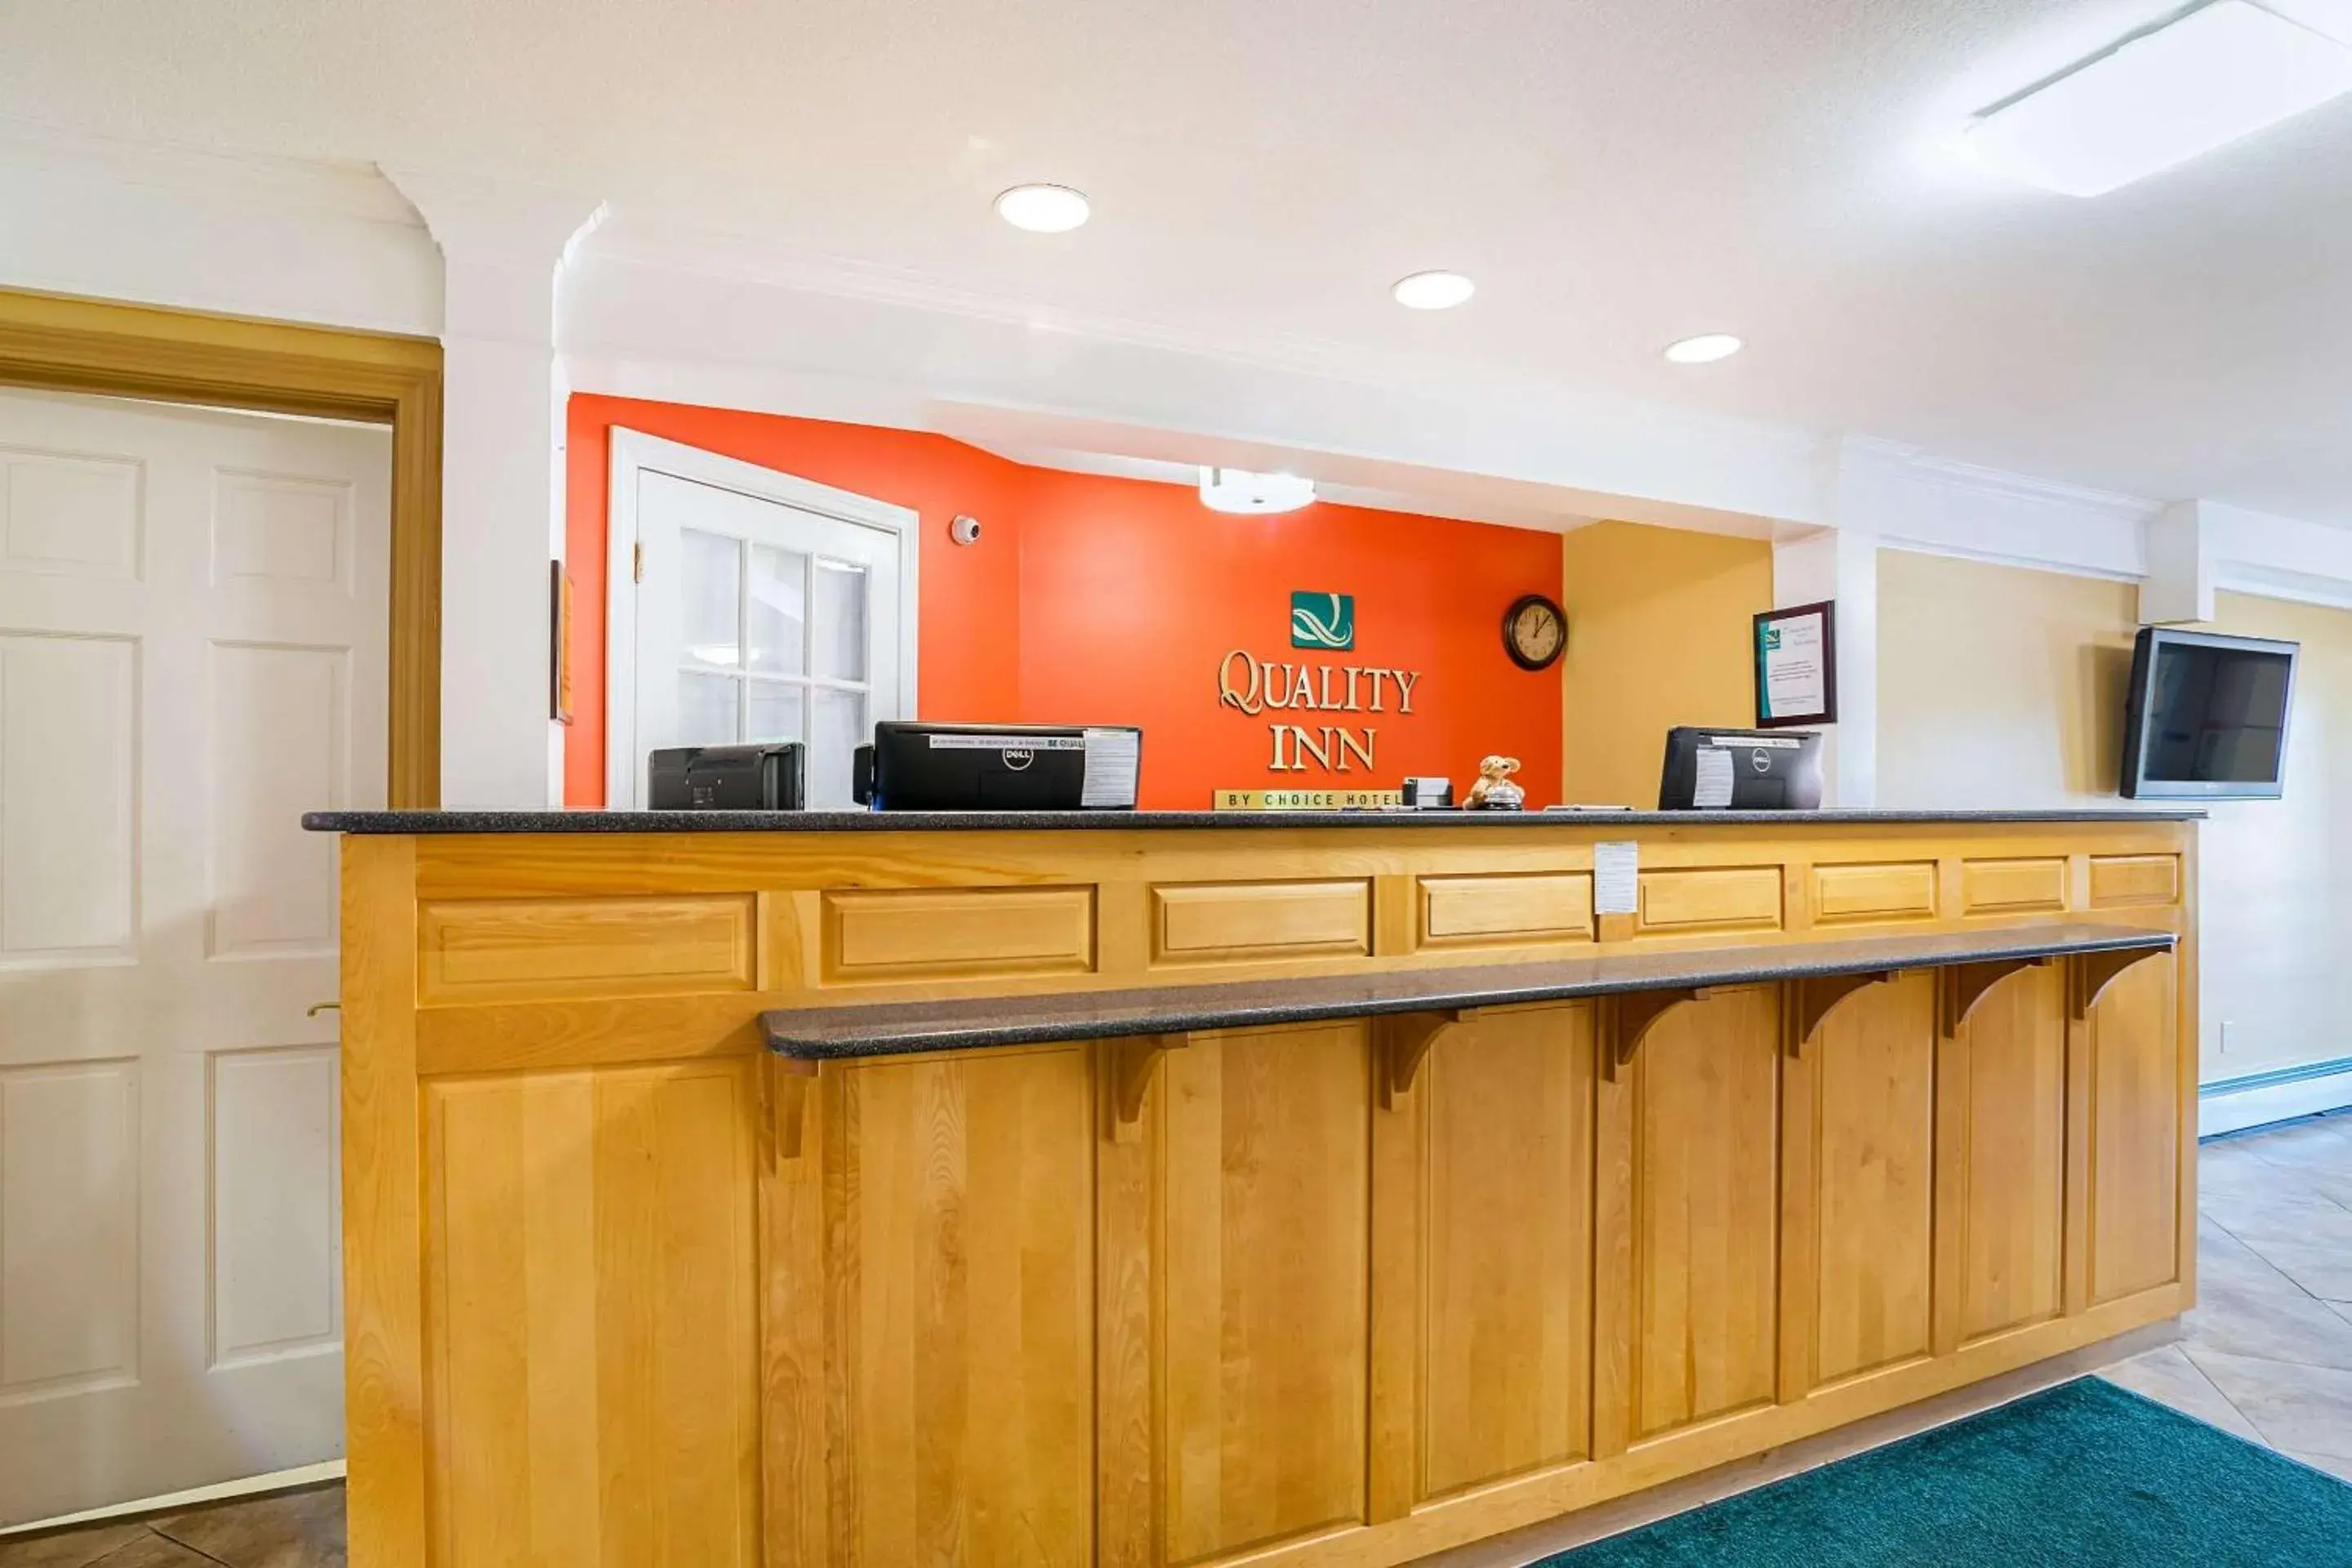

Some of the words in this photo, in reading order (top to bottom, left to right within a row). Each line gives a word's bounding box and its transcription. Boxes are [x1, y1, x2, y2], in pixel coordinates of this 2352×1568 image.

[1219, 650, 1421, 715] QUALITY
[1005, 750, 1031, 759] DELL
[1268, 724, 1377, 772] INN
[1228, 794, 1250, 805] BY
[1264, 794, 1334, 805] CHOICE
[1347, 795, 1402, 805] HOTEL
